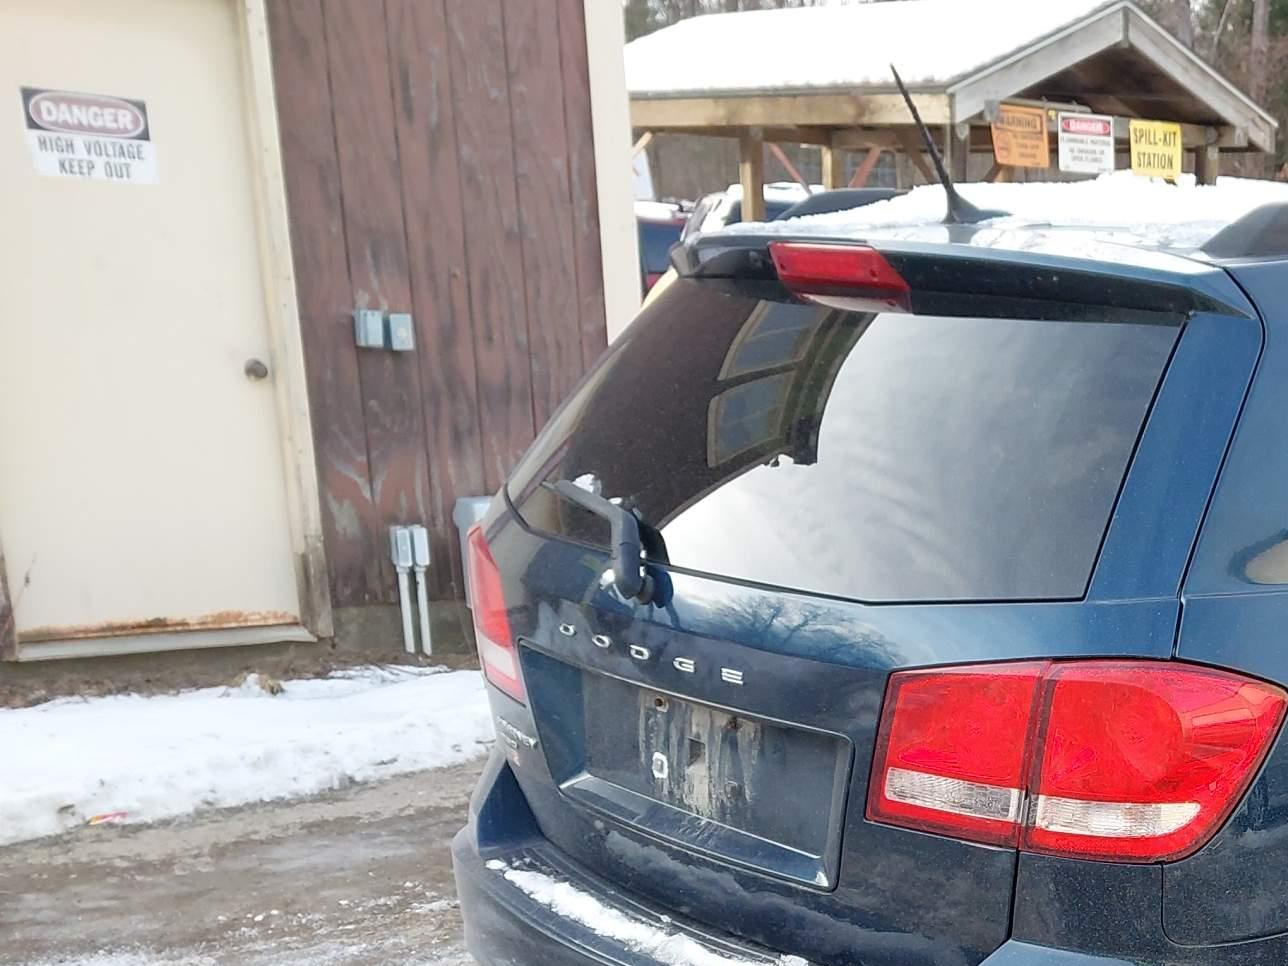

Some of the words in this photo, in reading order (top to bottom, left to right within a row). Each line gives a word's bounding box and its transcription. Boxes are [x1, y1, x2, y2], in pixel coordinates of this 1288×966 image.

[39, 100, 134, 130] DANGER
[37, 135, 75, 155] HIGH
[84, 141, 145, 161] VOLTAGE
[1134, 127, 1177, 147] SPILL-KIT
[58, 158, 96, 177] KEEP
[104, 160, 132, 179] OUT
[1137, 152, 1174, 169] STATION
[558, 623, 745, 685] DODGE
